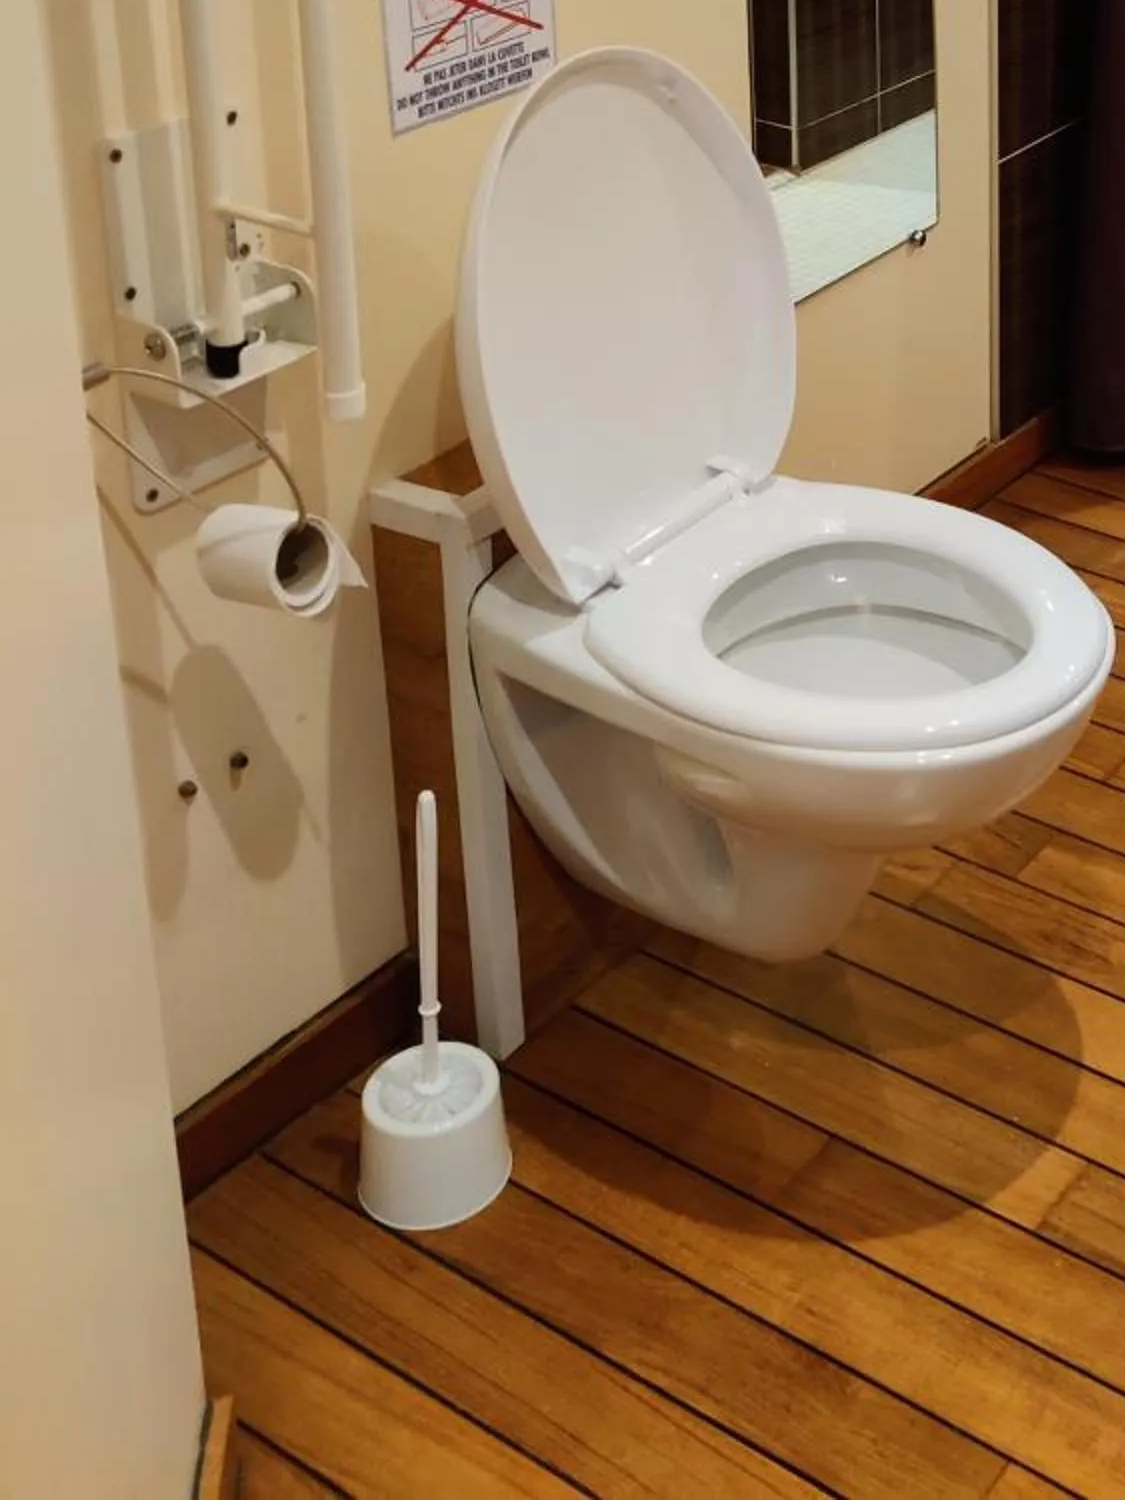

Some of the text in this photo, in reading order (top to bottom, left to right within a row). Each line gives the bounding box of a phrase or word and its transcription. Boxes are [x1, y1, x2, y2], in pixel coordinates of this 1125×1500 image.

[397, 97, 407, 111] DO
[410, 91, 422, 106] NOT
[425, 82, 450, 100] THROW
[452, 70, 486, 91] ANYTHING
[487, 66, 495, 78] IN
[496, 61, 508, 74] THE
[509, 53, 530, 68] TOILET
[434, 69, 446, 82] PAS
[449, 62, 466, 77] JETER
[468, 55, 486, 72] DANS
[488, 51, 496, 64] LA
